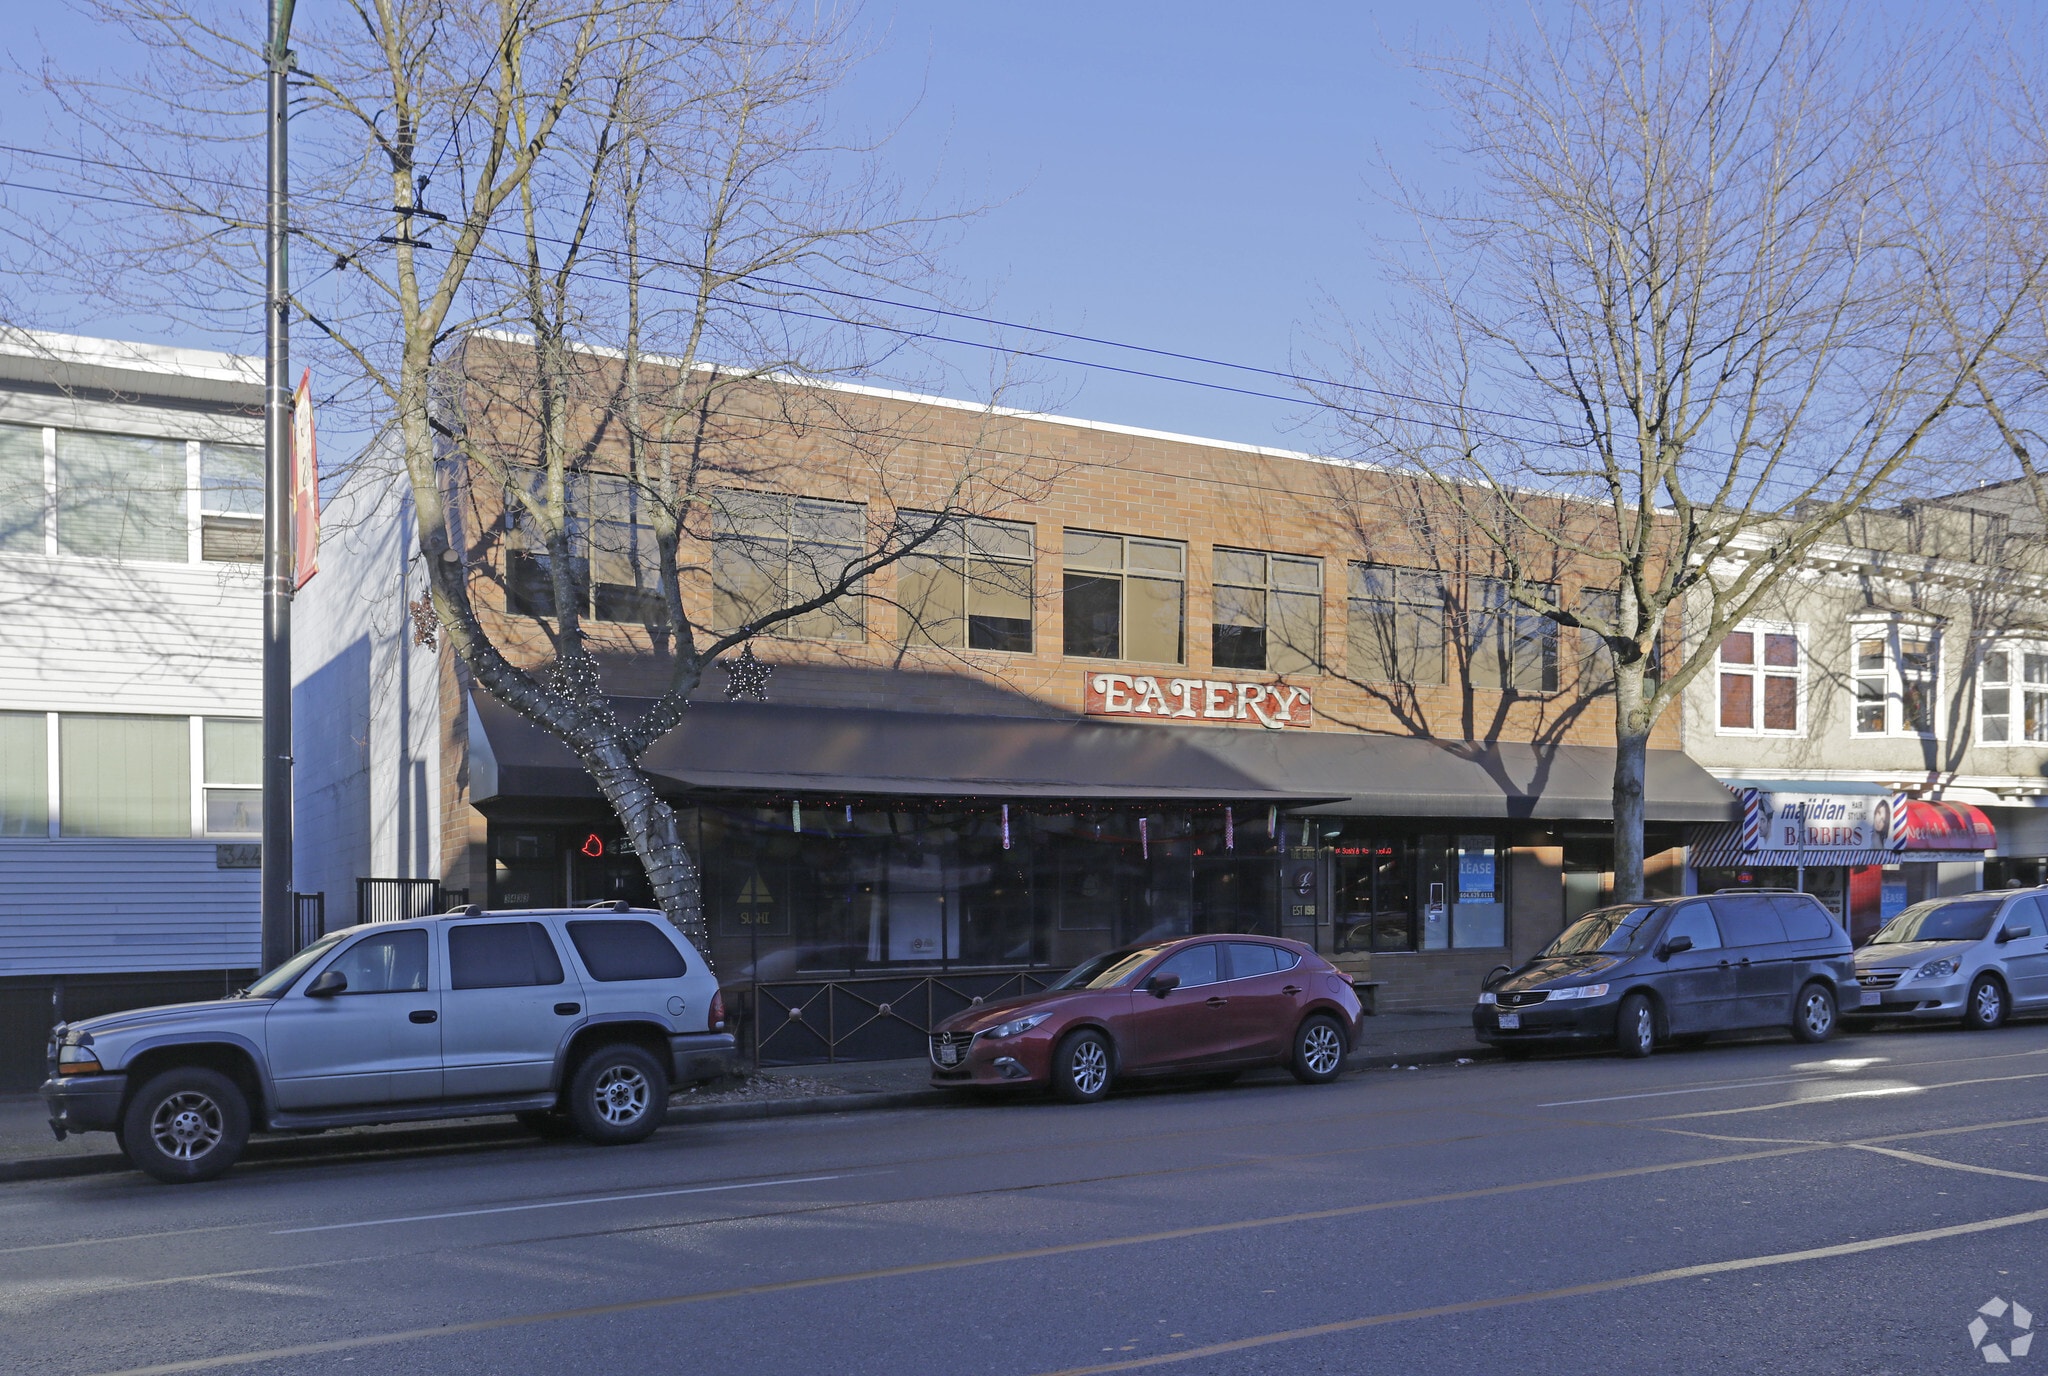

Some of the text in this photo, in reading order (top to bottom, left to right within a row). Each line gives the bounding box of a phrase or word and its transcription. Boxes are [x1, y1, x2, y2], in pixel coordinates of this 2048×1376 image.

[1092, 673, 1310, 729] EATERY
[1852, 801, 1863, 809] HAIR
[1784, 826, 1863, 846] BARBERS
[1460, 863, 1491, 874] LEASE
[1881, 893, 1904, 903] LEASE
[1292, 905, 1303, 916] EST
